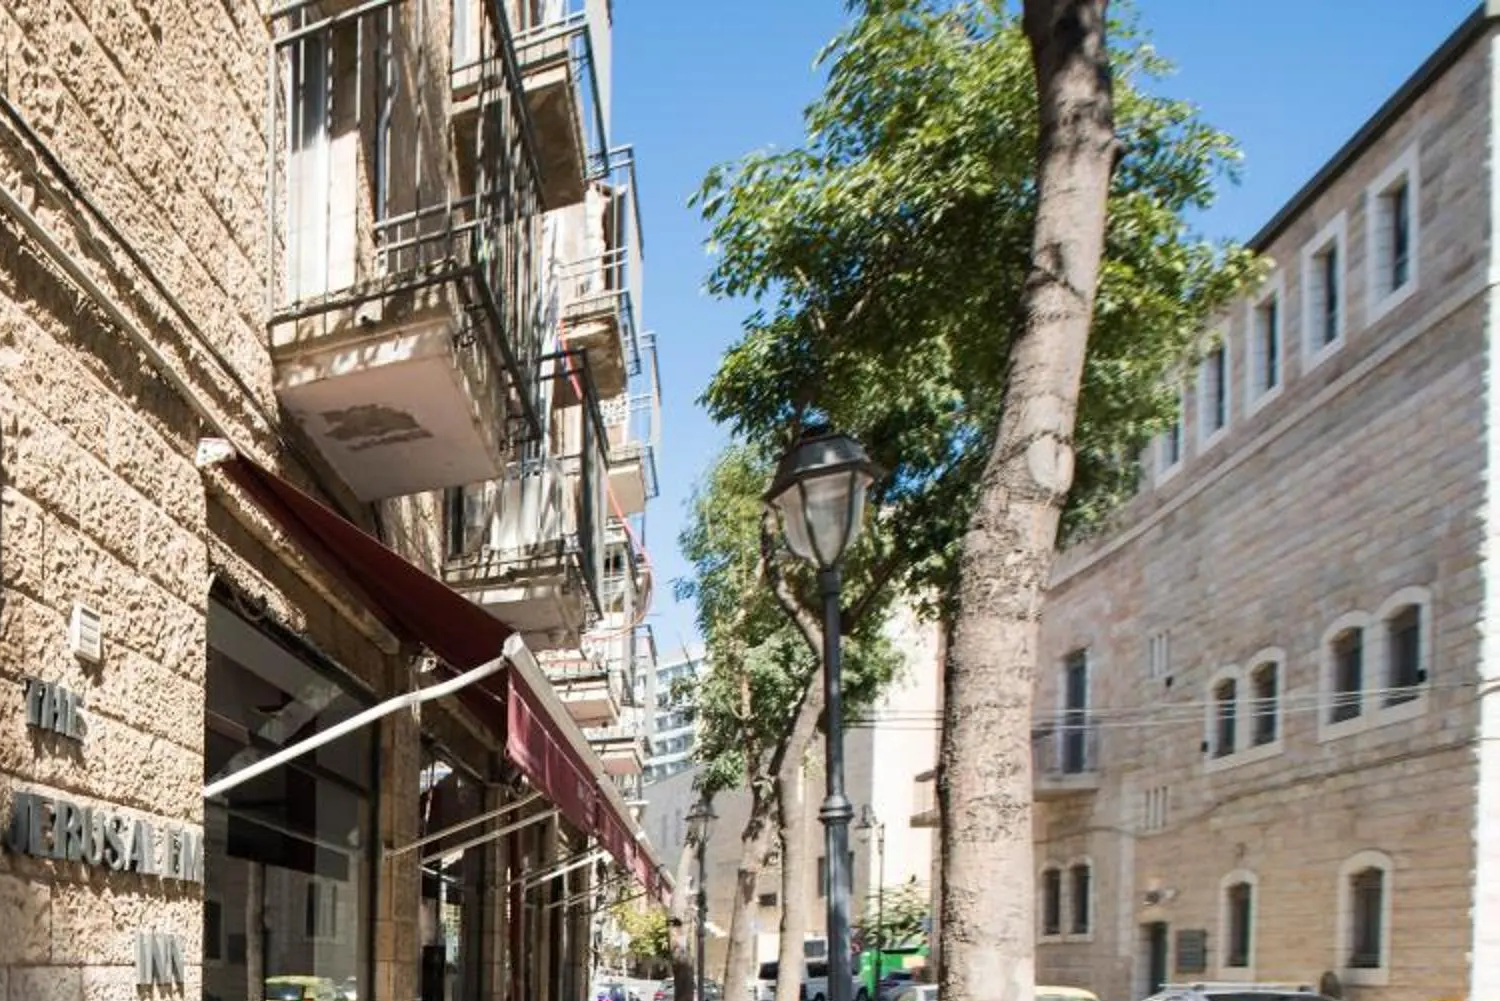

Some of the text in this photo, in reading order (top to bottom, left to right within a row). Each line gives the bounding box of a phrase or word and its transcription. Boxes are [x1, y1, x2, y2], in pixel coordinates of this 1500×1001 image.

[20, 676, 84, 744] THE
[6, 790, 203, 882] JERUSALEM
[135, 931, 185, 986] INN
